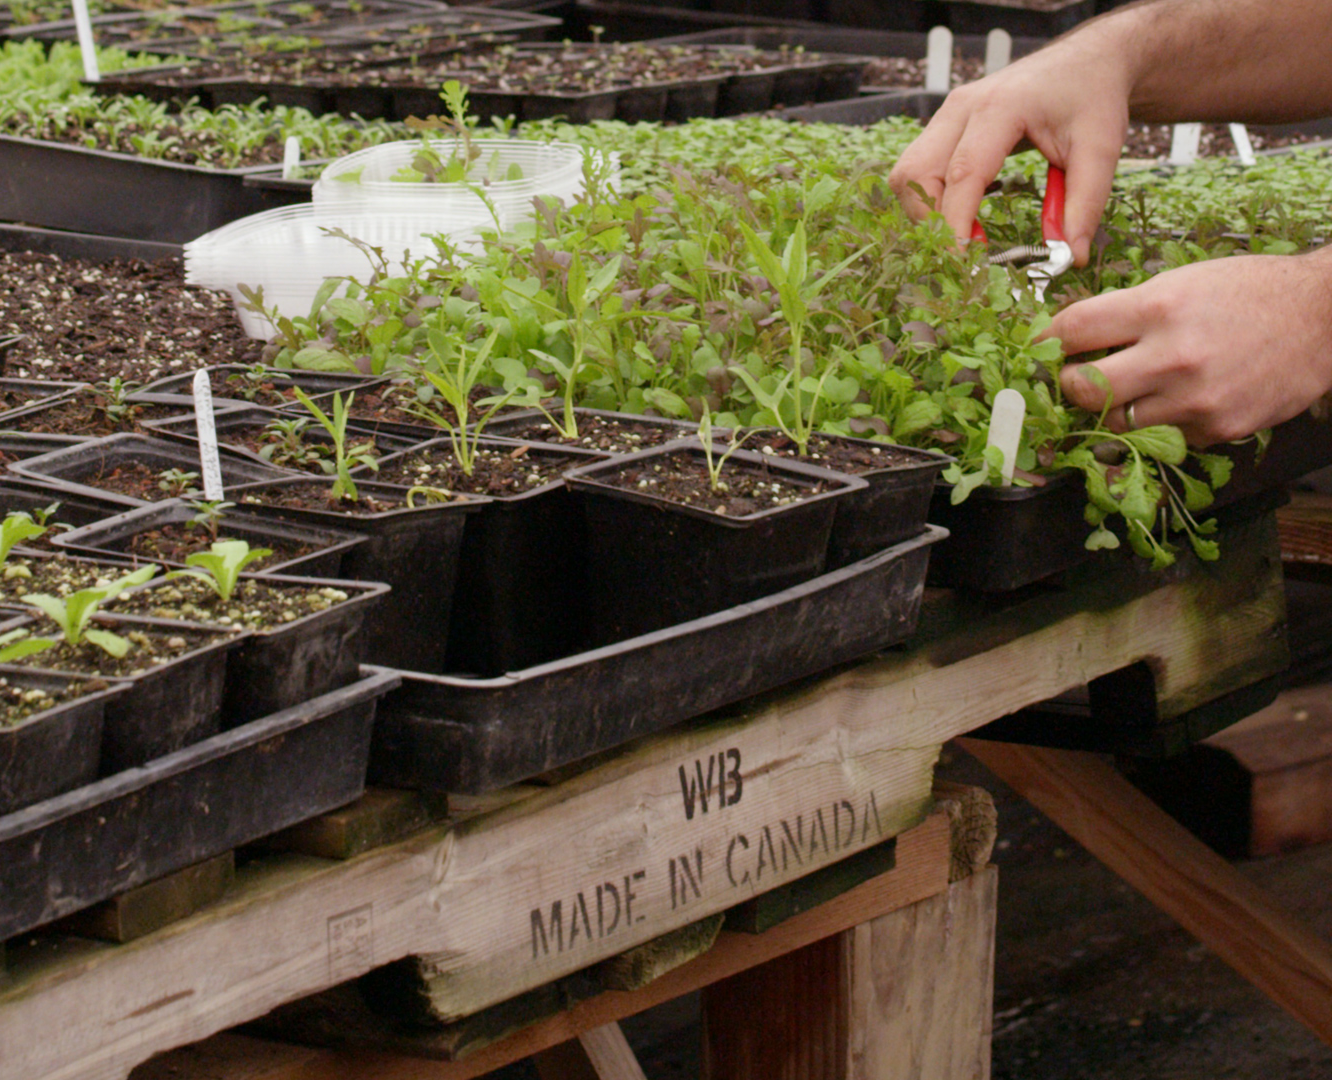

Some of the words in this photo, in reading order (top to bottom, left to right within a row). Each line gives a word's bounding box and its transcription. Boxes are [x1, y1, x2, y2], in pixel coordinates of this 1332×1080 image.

[678, 747, 744, 821] WB
[530, 870, 646, 961] MADE
[668, 846, 703, 910] IN
[726, 790, 882, 887] CANADA
